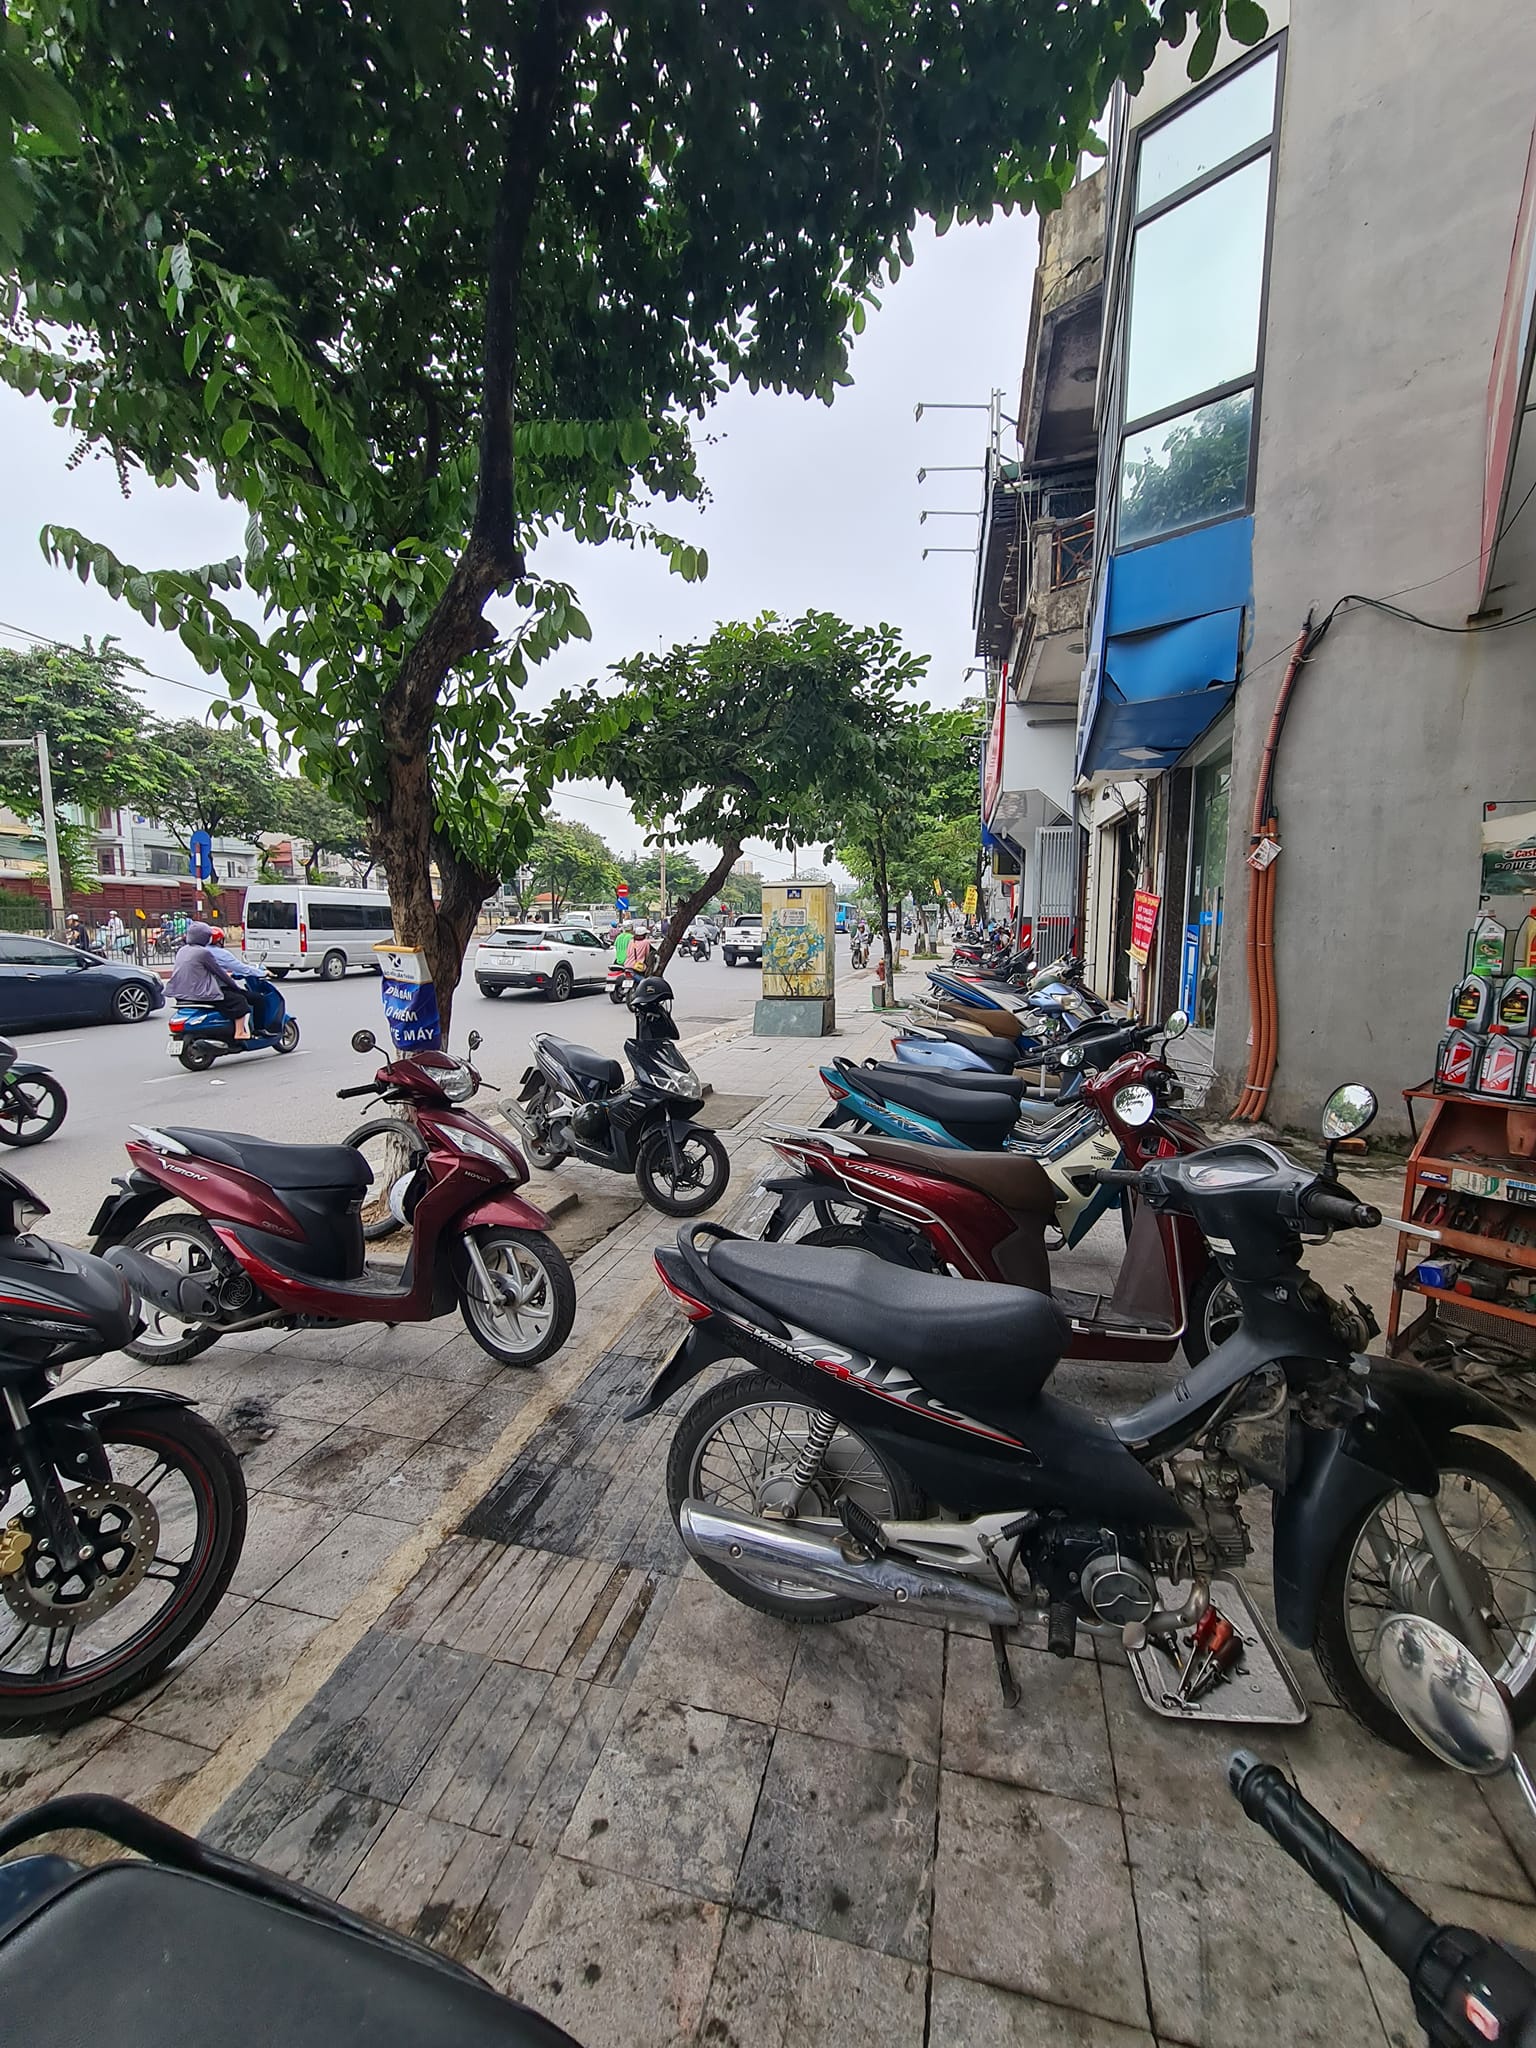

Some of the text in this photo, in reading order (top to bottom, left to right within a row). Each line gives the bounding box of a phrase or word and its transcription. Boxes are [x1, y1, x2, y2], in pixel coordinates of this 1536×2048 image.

[403, 1026, 434, 1041] MÁY
[158, 1157, 209, 1181] VISION
[464, 1170, 491, 1184] HONDA
[844, 1161, 904, 1182] VISION
